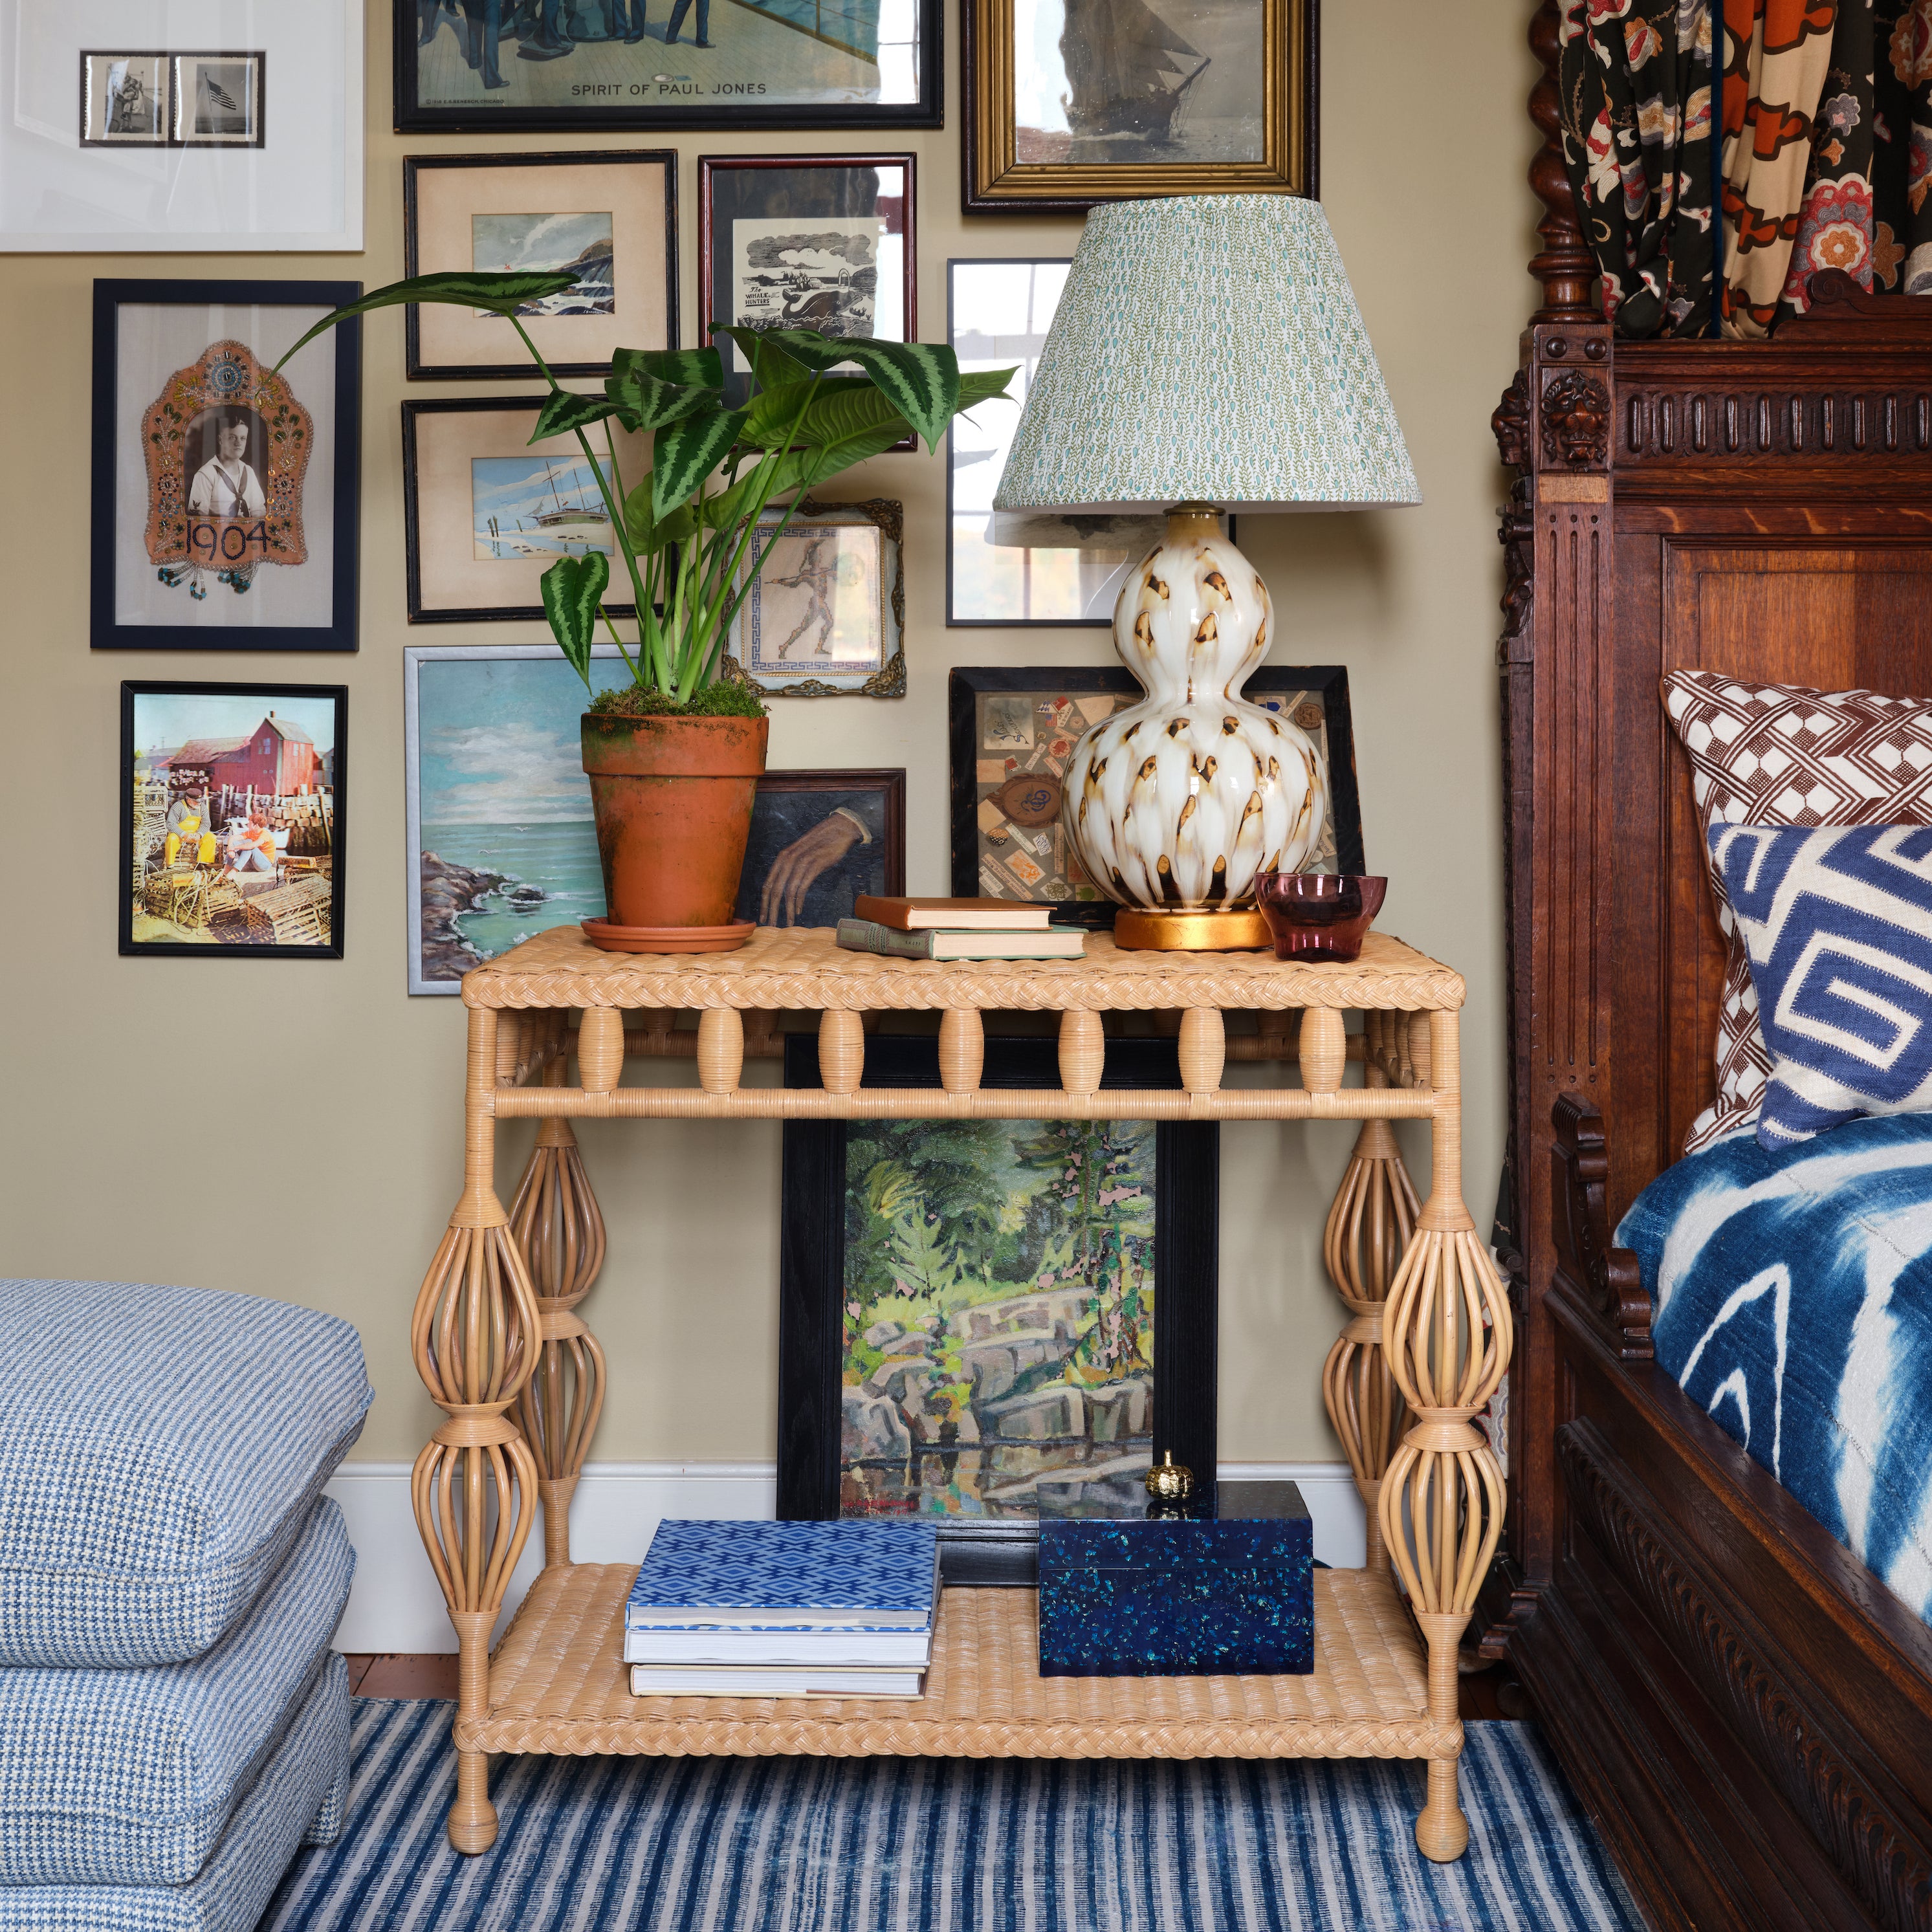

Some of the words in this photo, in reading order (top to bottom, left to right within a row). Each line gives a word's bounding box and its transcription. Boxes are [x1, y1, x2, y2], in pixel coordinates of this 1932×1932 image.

[571, 85, 622, 95] SPIRIT
[630, 85, 650, 95] OF
[659, 84, 704, 94] PAUL
[712, 83, 766, 94] JONES
[186, 520, 270, 561] 1904
